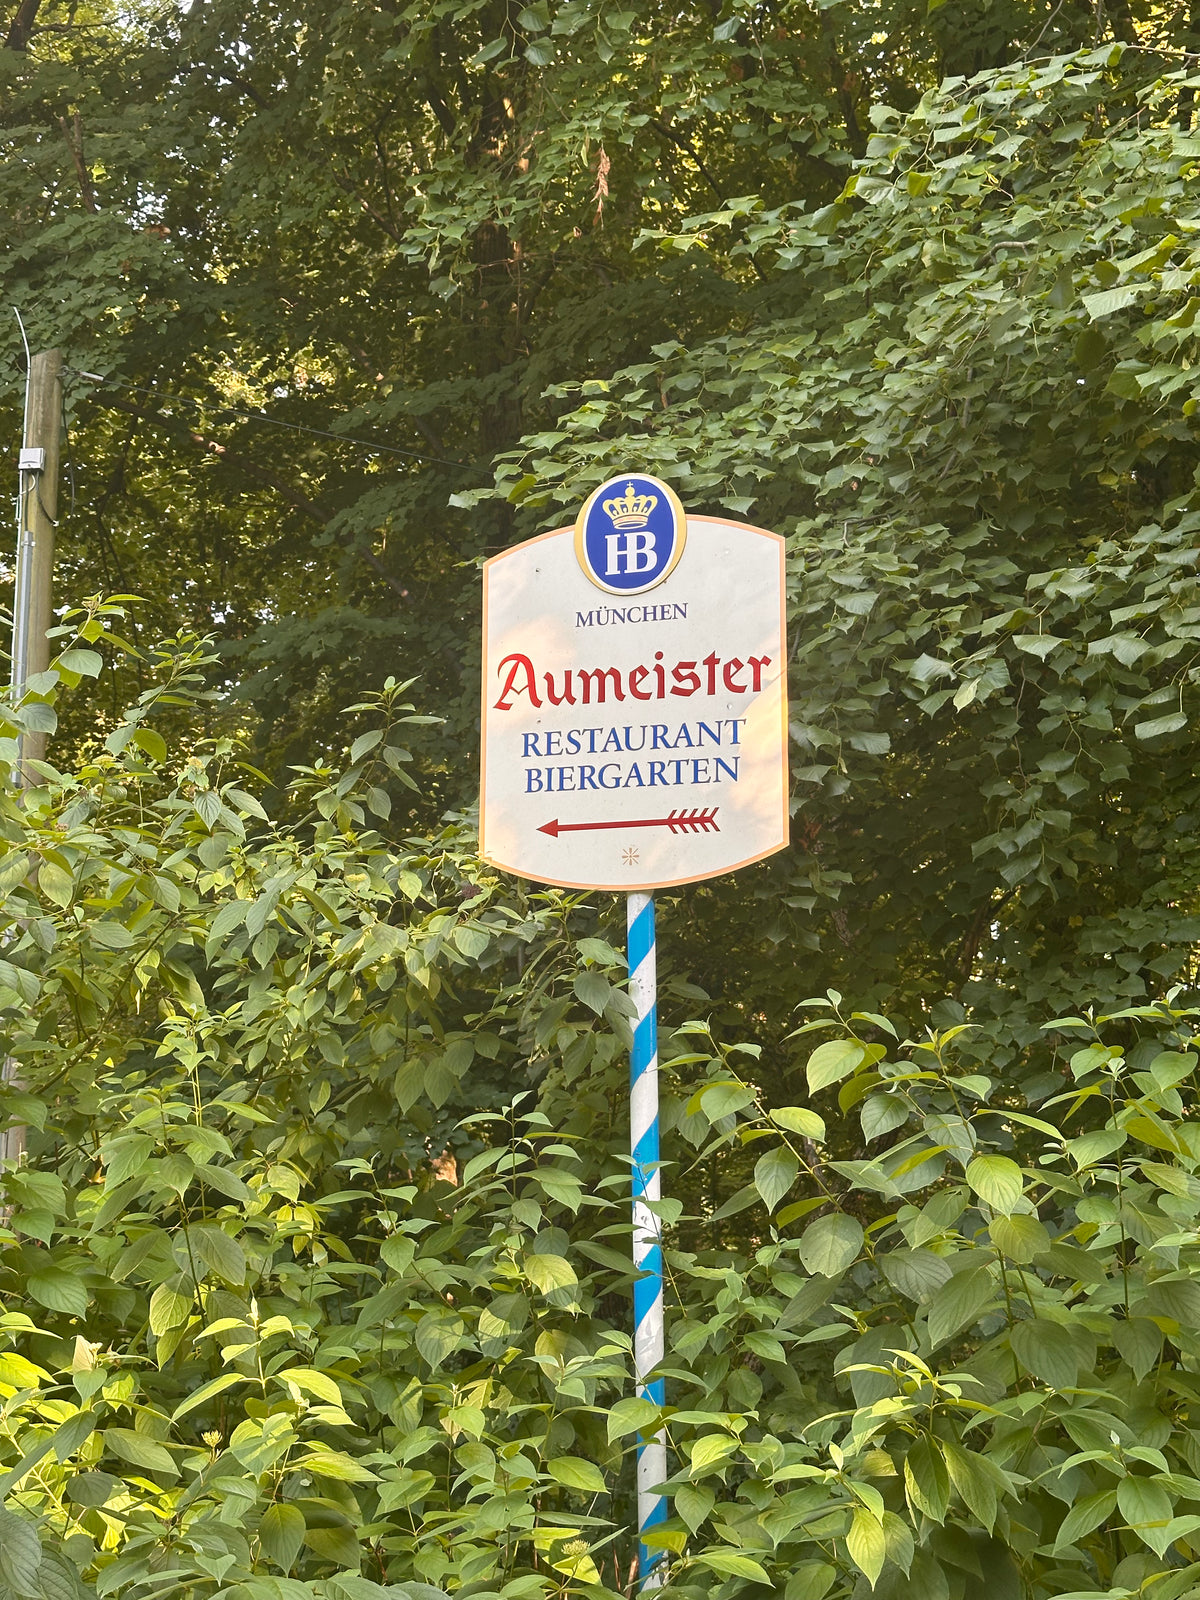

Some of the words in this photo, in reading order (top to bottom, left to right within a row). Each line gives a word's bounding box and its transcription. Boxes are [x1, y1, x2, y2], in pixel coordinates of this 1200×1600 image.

[604, 530, 658, 576] HB
[575, 603, 688, 628] MÜNCHEN
[493, 650, 772, 711] Aumeister
[521, 718, 746, 758] RESTAURANT
[524, 757, 739, 793] BIERGARTEN
